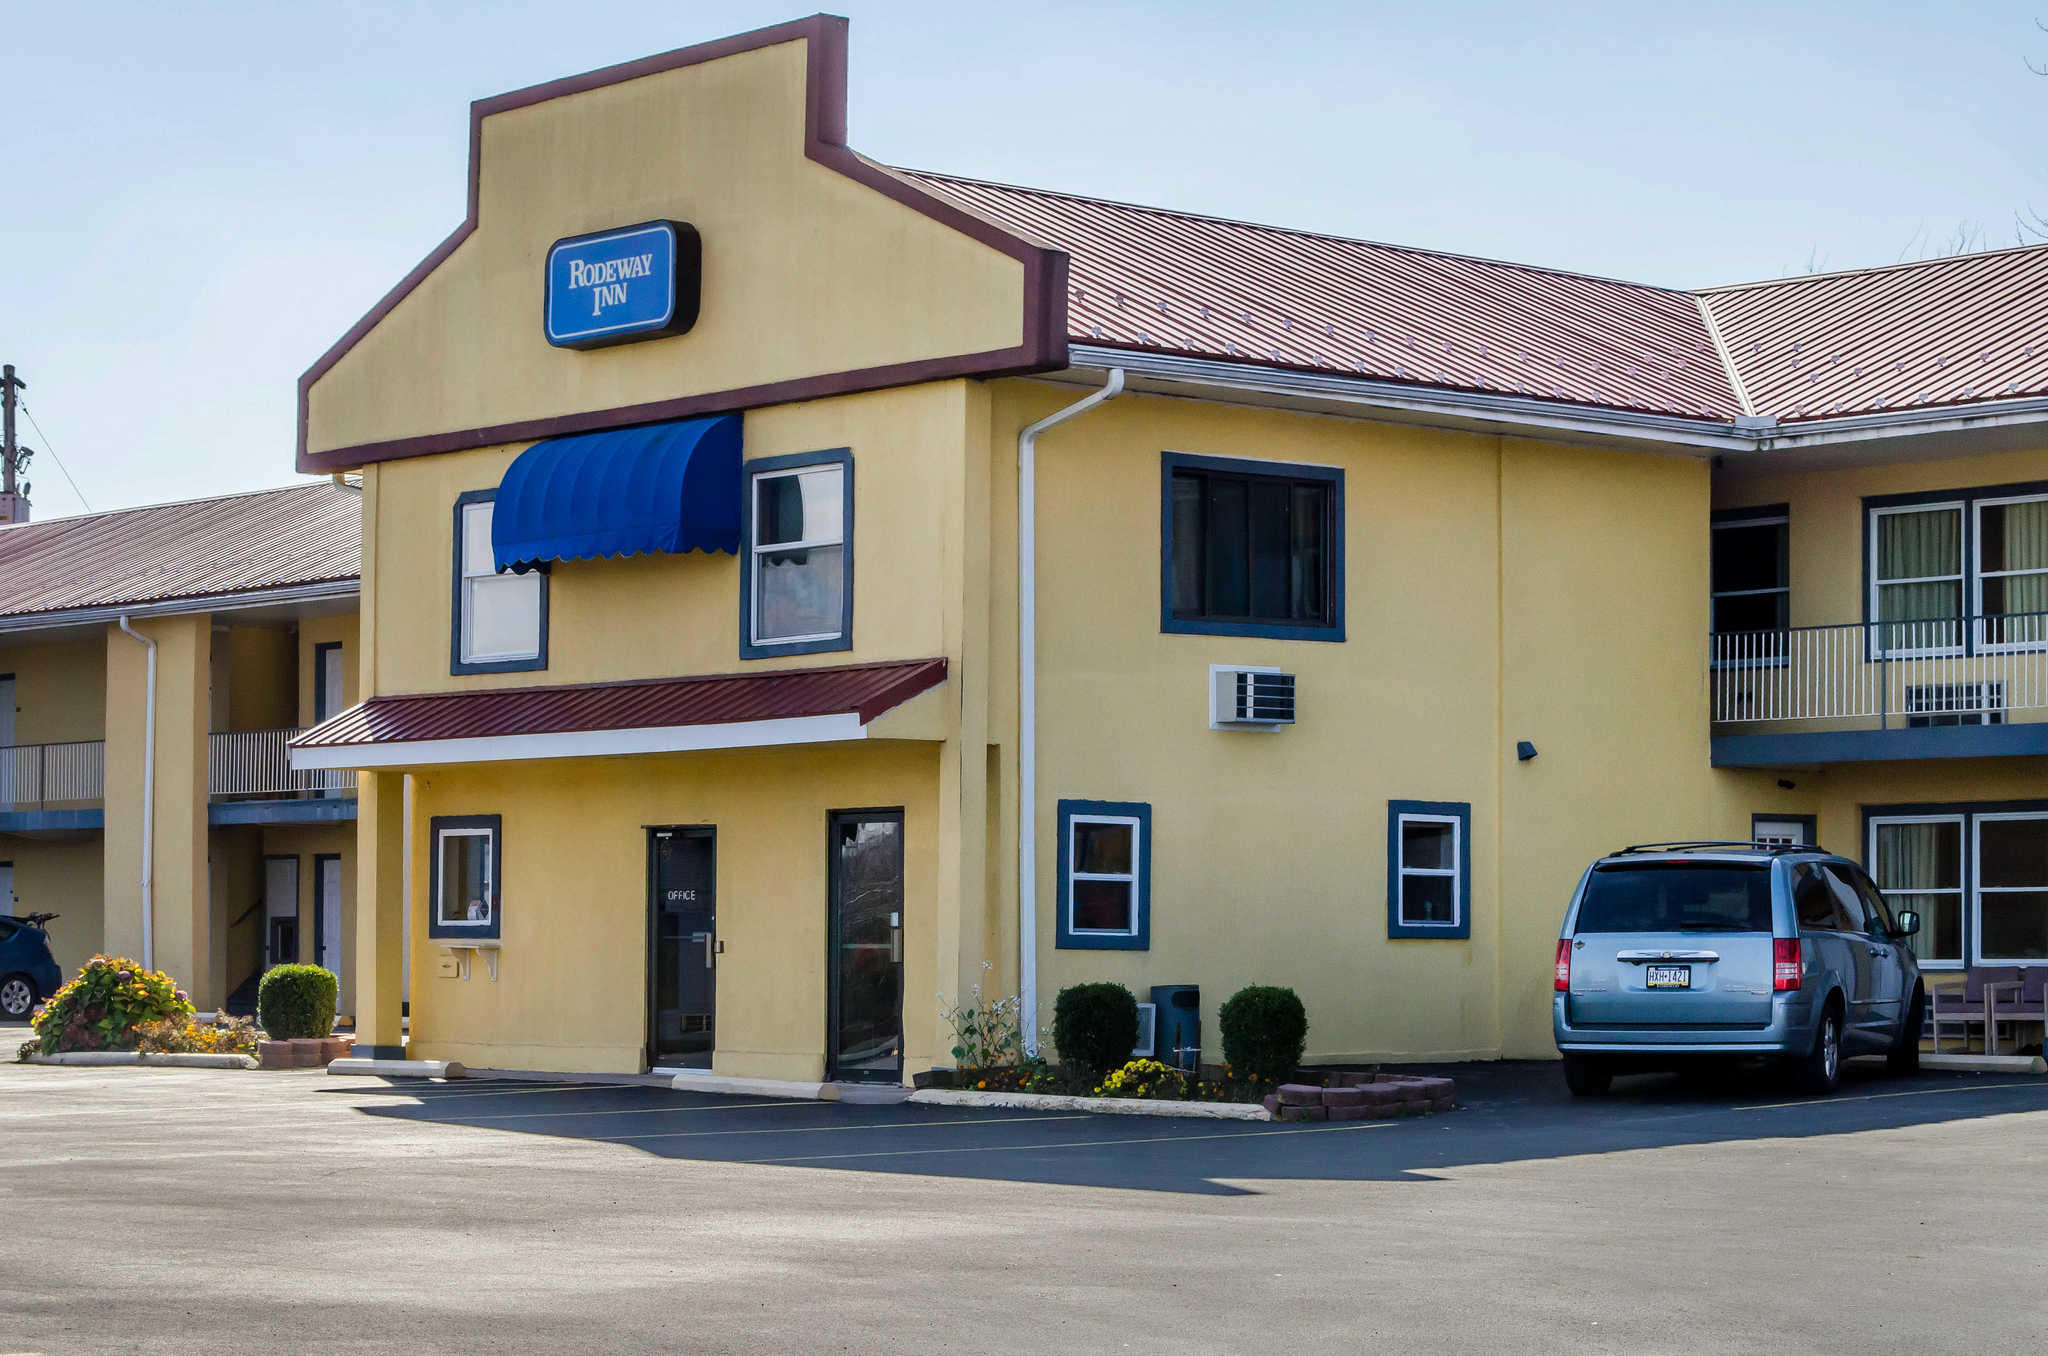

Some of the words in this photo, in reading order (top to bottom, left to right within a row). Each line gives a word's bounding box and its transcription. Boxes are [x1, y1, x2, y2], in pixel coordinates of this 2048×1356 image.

[568, 253, 653, 289] RODEWAY
[592, 282, 628, 316] INN
[667, 890, 696, 901] OFFICE
